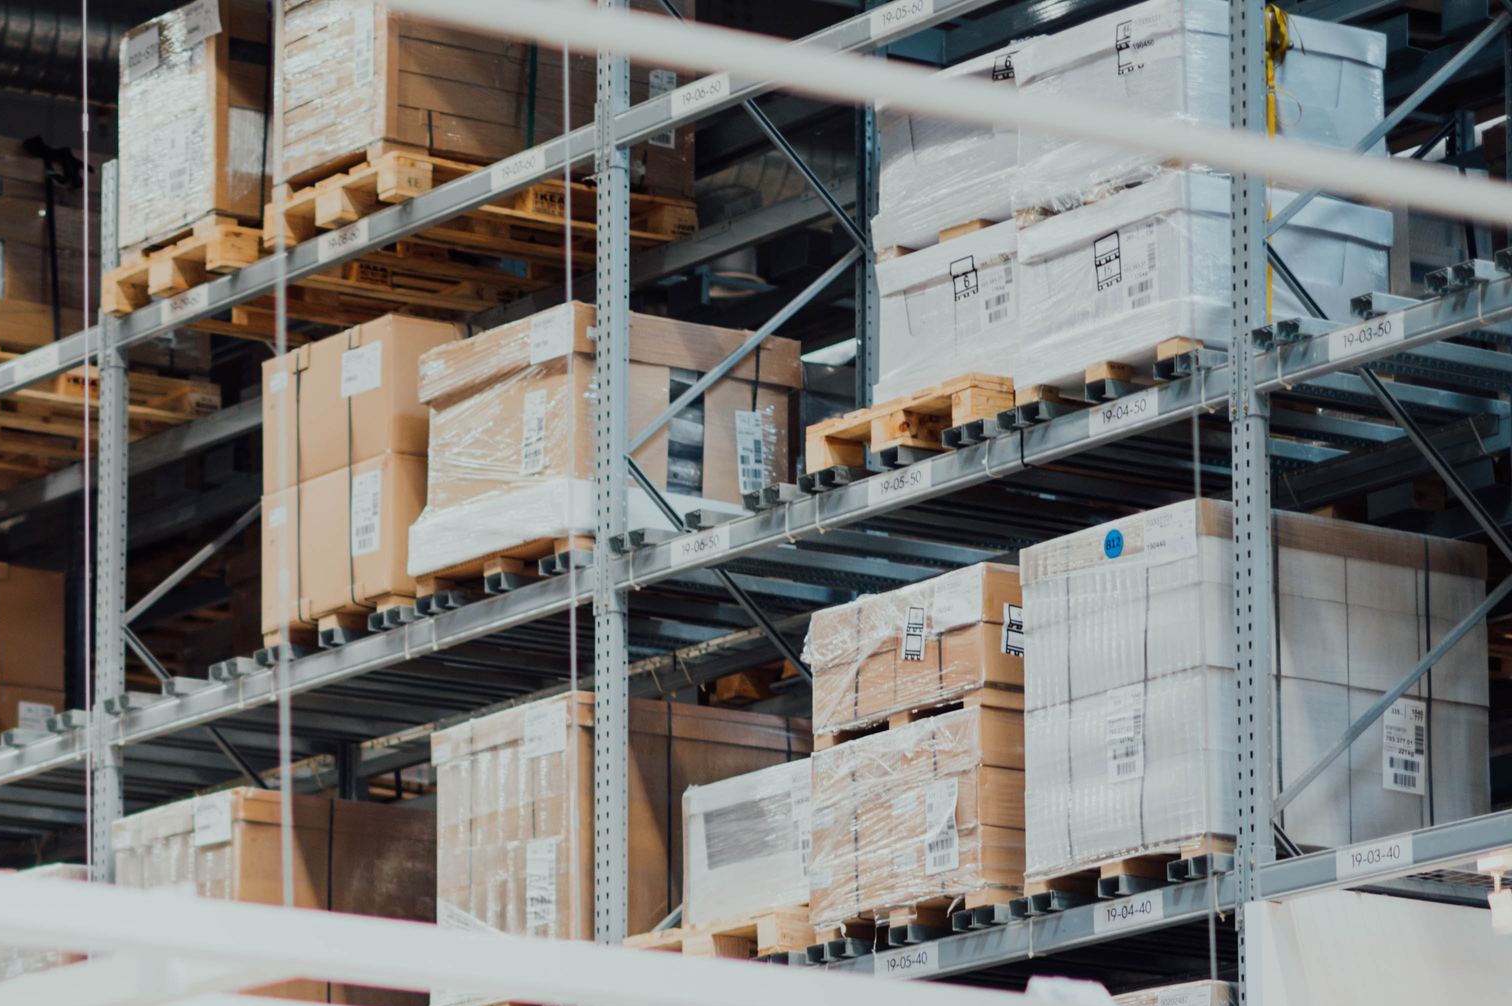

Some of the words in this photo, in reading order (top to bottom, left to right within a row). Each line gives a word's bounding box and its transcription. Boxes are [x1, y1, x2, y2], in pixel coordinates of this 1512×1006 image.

[1343, 320, 1392, 349] 19-03-50
[1102, 398, 1147, 425] 19-04-50
[880, 470, 923, 495] 19-05-50
[681, 534, 719, 555] 19-06-50
[1351, 844, 1400, 868] 19-03-40
[1106, 900, 1152, 922] 19-04-40
[886, 951, 928, 973] 19-05-40
